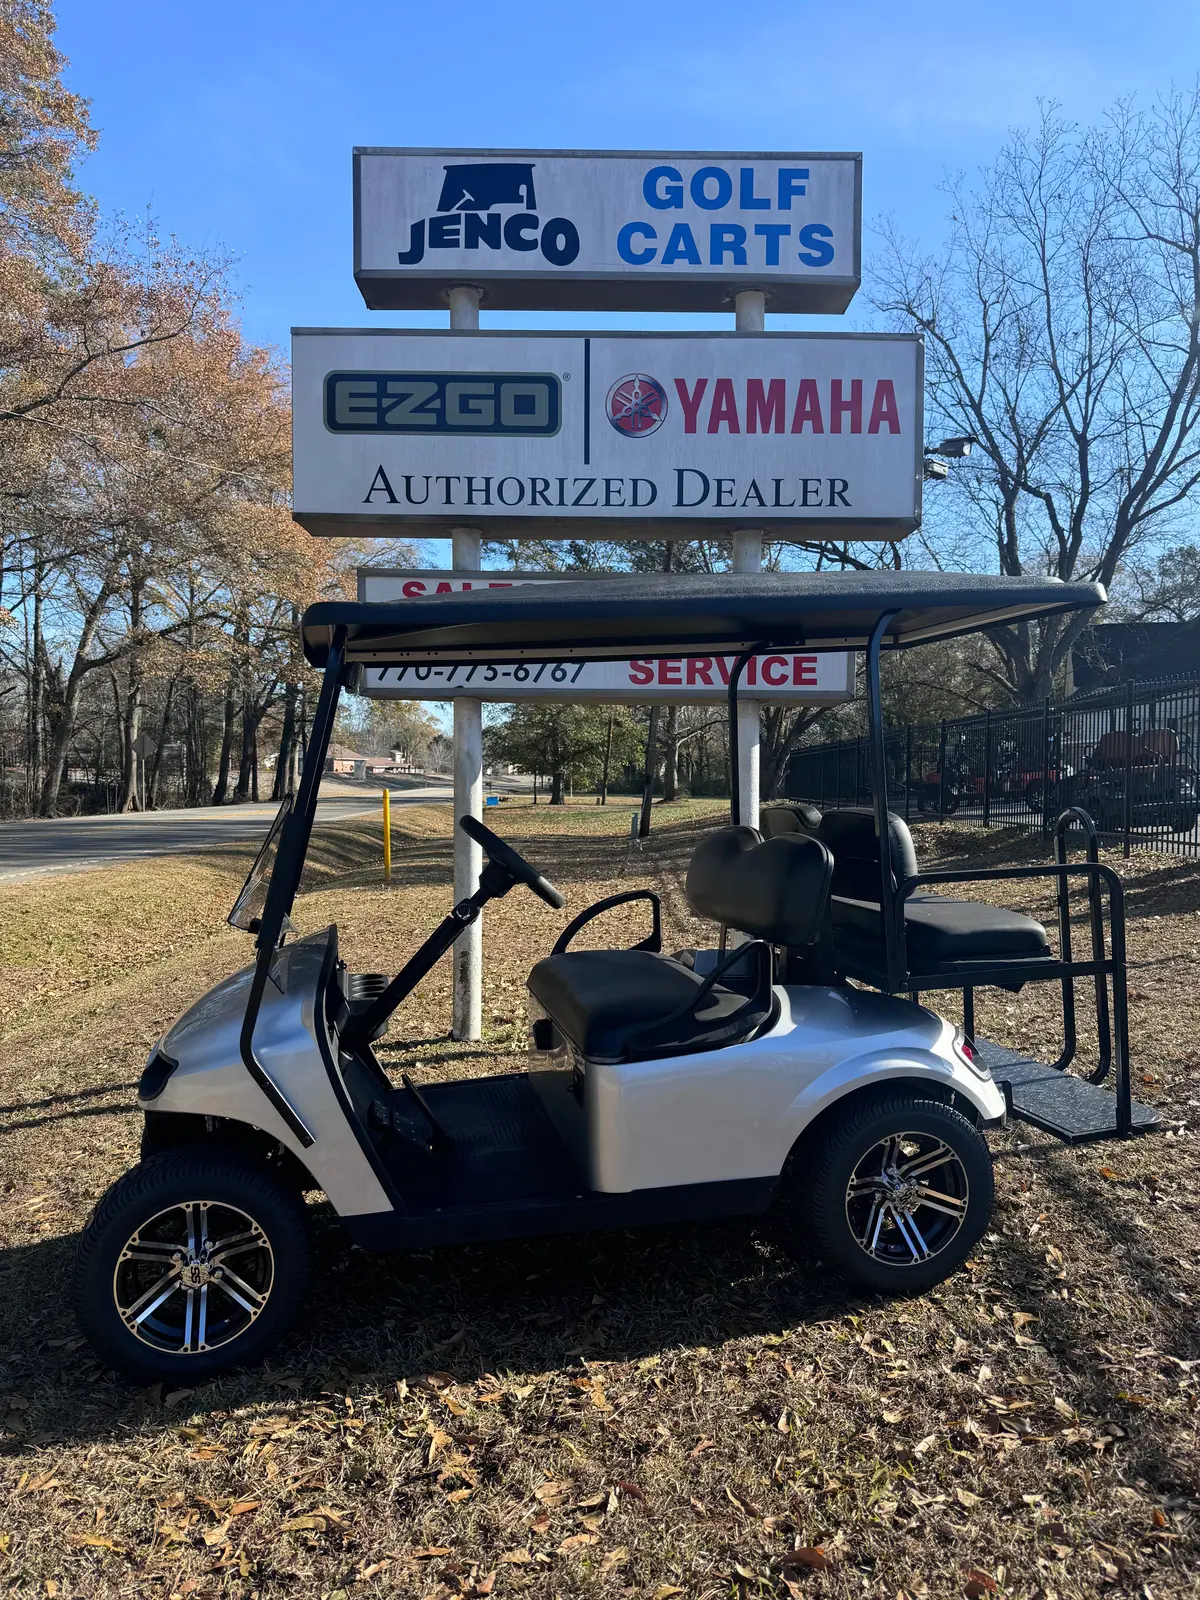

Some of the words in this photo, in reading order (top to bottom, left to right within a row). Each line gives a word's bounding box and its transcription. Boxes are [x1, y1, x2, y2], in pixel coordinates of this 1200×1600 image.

[643, 166, 809, 210] GOLF
[398, 213, 580, 266] JENCO
[617, 222, 834, 267] CARTS
[674, 378, 900, 434] YAMAHA
[362, 464, 658, 507] AUTHORIZED
[673, 468, 852, 508] DEALER
[628, 655, 818, 686] SERVICE
